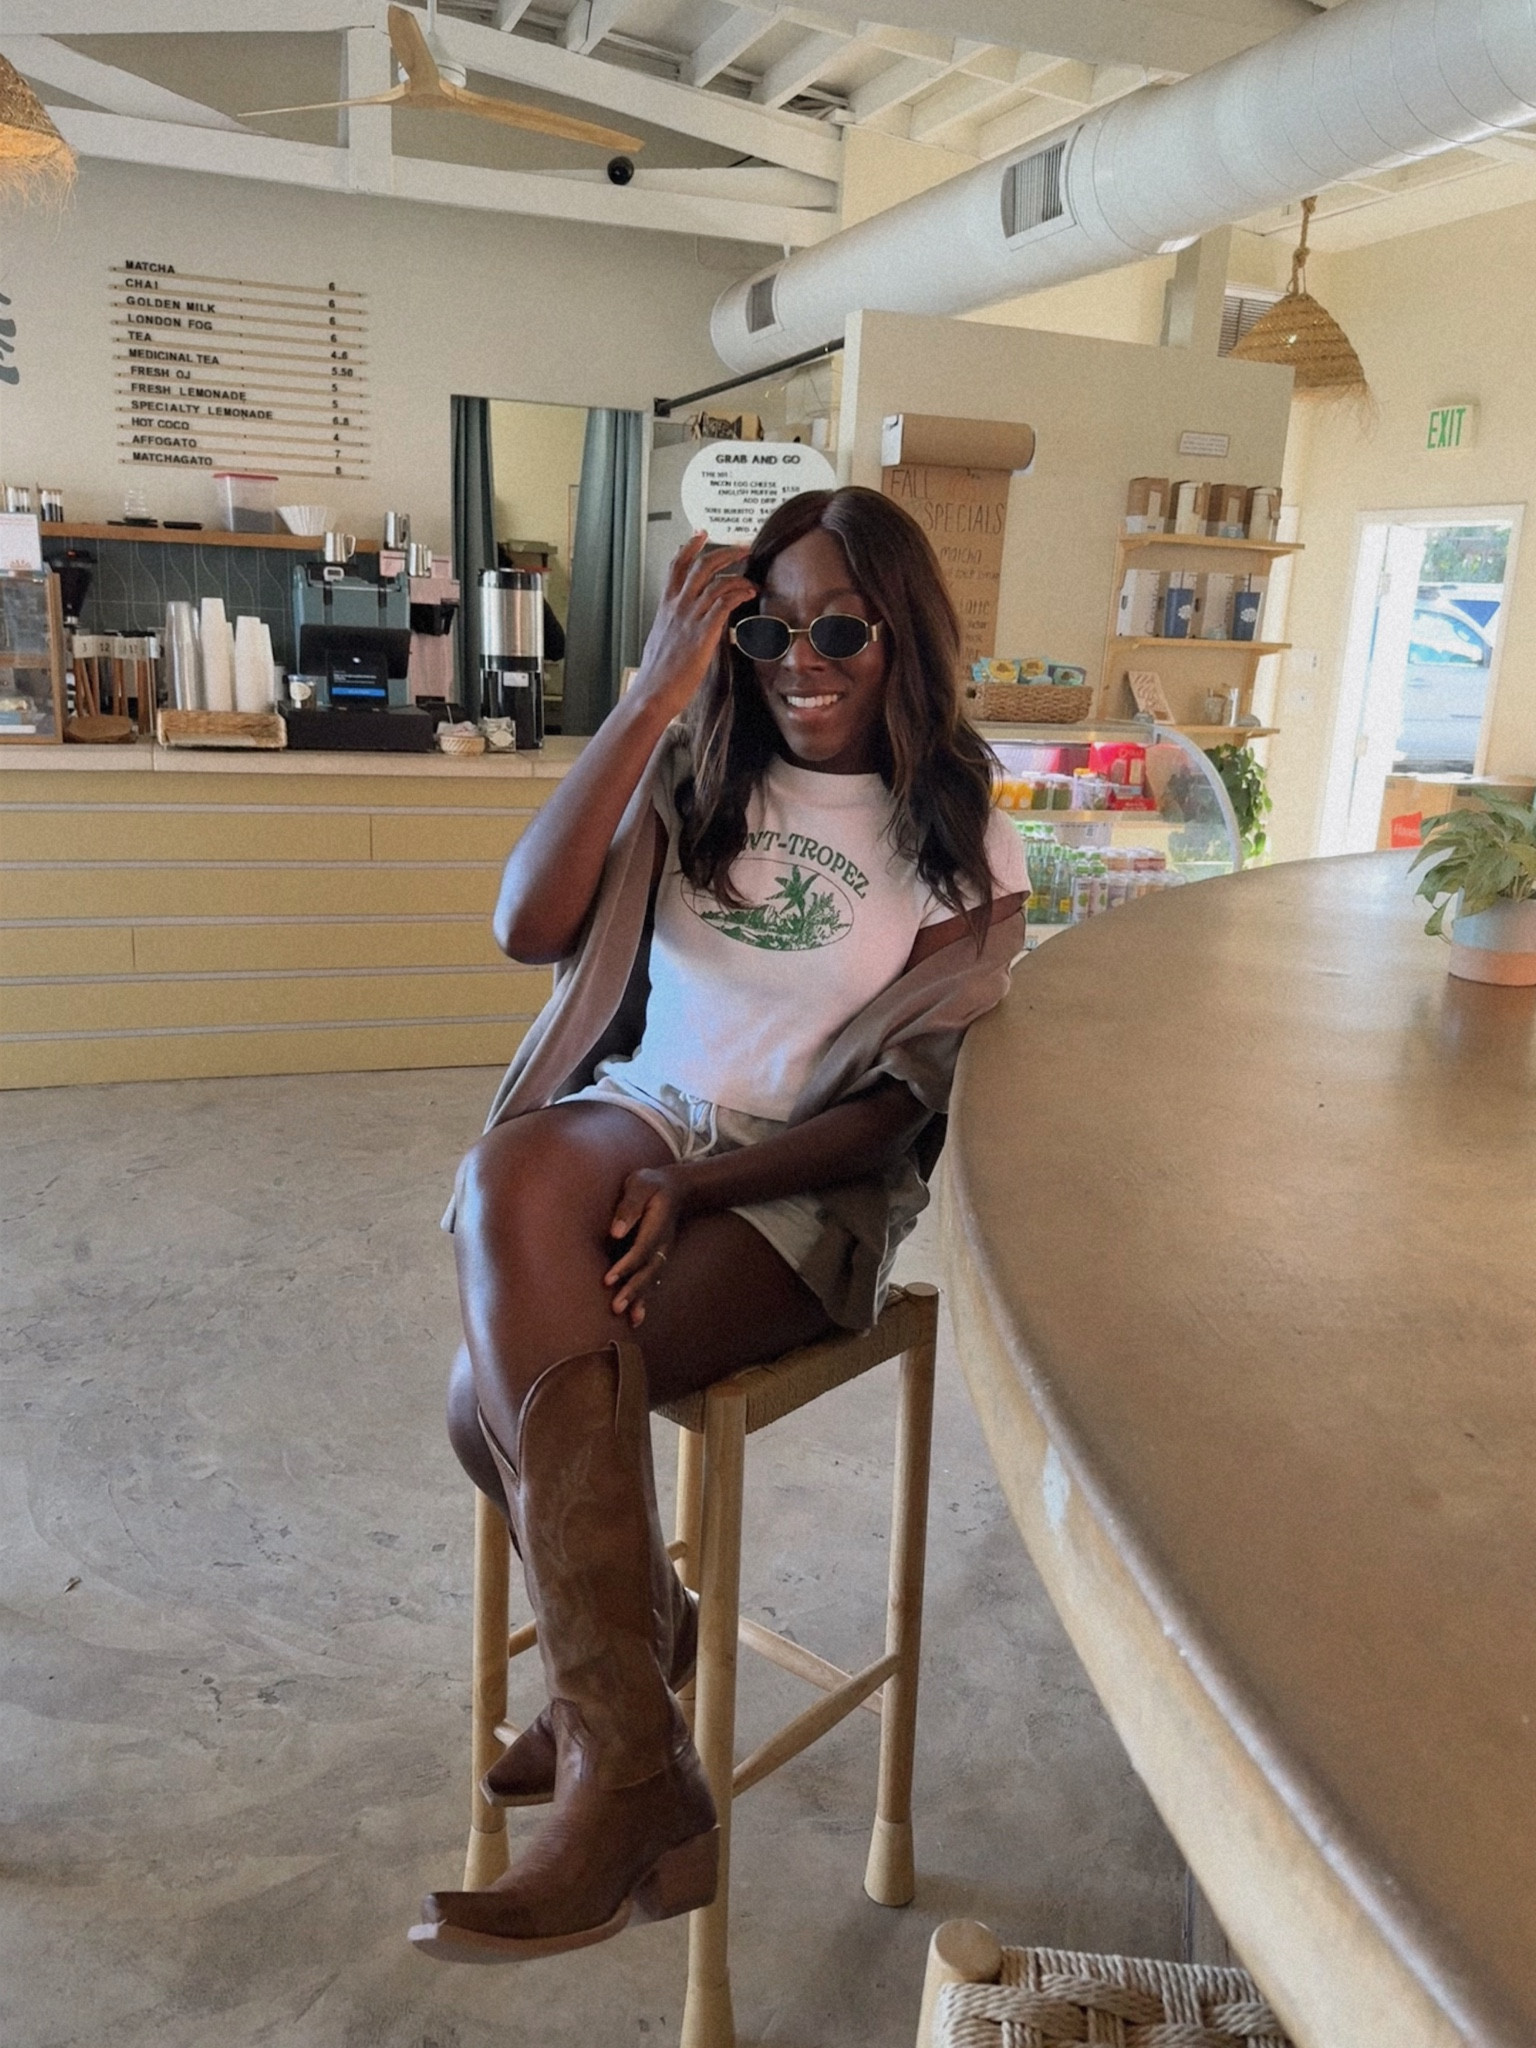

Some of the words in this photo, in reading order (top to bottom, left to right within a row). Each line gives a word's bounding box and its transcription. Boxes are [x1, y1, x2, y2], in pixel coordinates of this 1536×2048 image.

[125, 260, 175, 274] MATCHA
[329, 282, 335, 291] 6
[125, 278, 159, 290] CHAI
[329, 299, 336, 308] 6
[126, 296, 181, 310] GOLDEN
[186, 302, 216, 313] MILK
[329, 316, 336, 325] 6
[128, 314, 181, 327] LONDON
[188, 319, 213, 331] FOG
[330, 334, 337, 343] 6
[128, 331, 152, 342] TEA
[129, 348, 193, 363] MEDICINAL
[196, 353, 220, 365] TEA
[130, 365, 170, 378] FRESH
[176, 370, 191, 380] OJ
[332, 383, 338, 392] 5
[131, 383, 171, 395] FRESH
[180, 387, 247, 401] LEMONADE
[332, 400, 338, 409] 5
[131, 400, 200, 414] SPECIALTY
[208, 406, 273, 420] LEMONADE
[131, 417, 154, 427] HOT
[157, 419, 190, 430] COCO
[333, 433, 339, 441] 4
[1428, 408, 1466, 449] EXIT
[132, 435, 197, 448] AFFOGATO
[335, 449, 341, 458] 7
[133, 452, 213, 466] MATCHAGATO
[716, 454, 747, 464] GRAB
[752, 455, 777, 465] AND
[782, 455, 801, 465] GO
[891, 469, 931, 499] FALL
[924, 501, 1005, 535] SPECIALS
